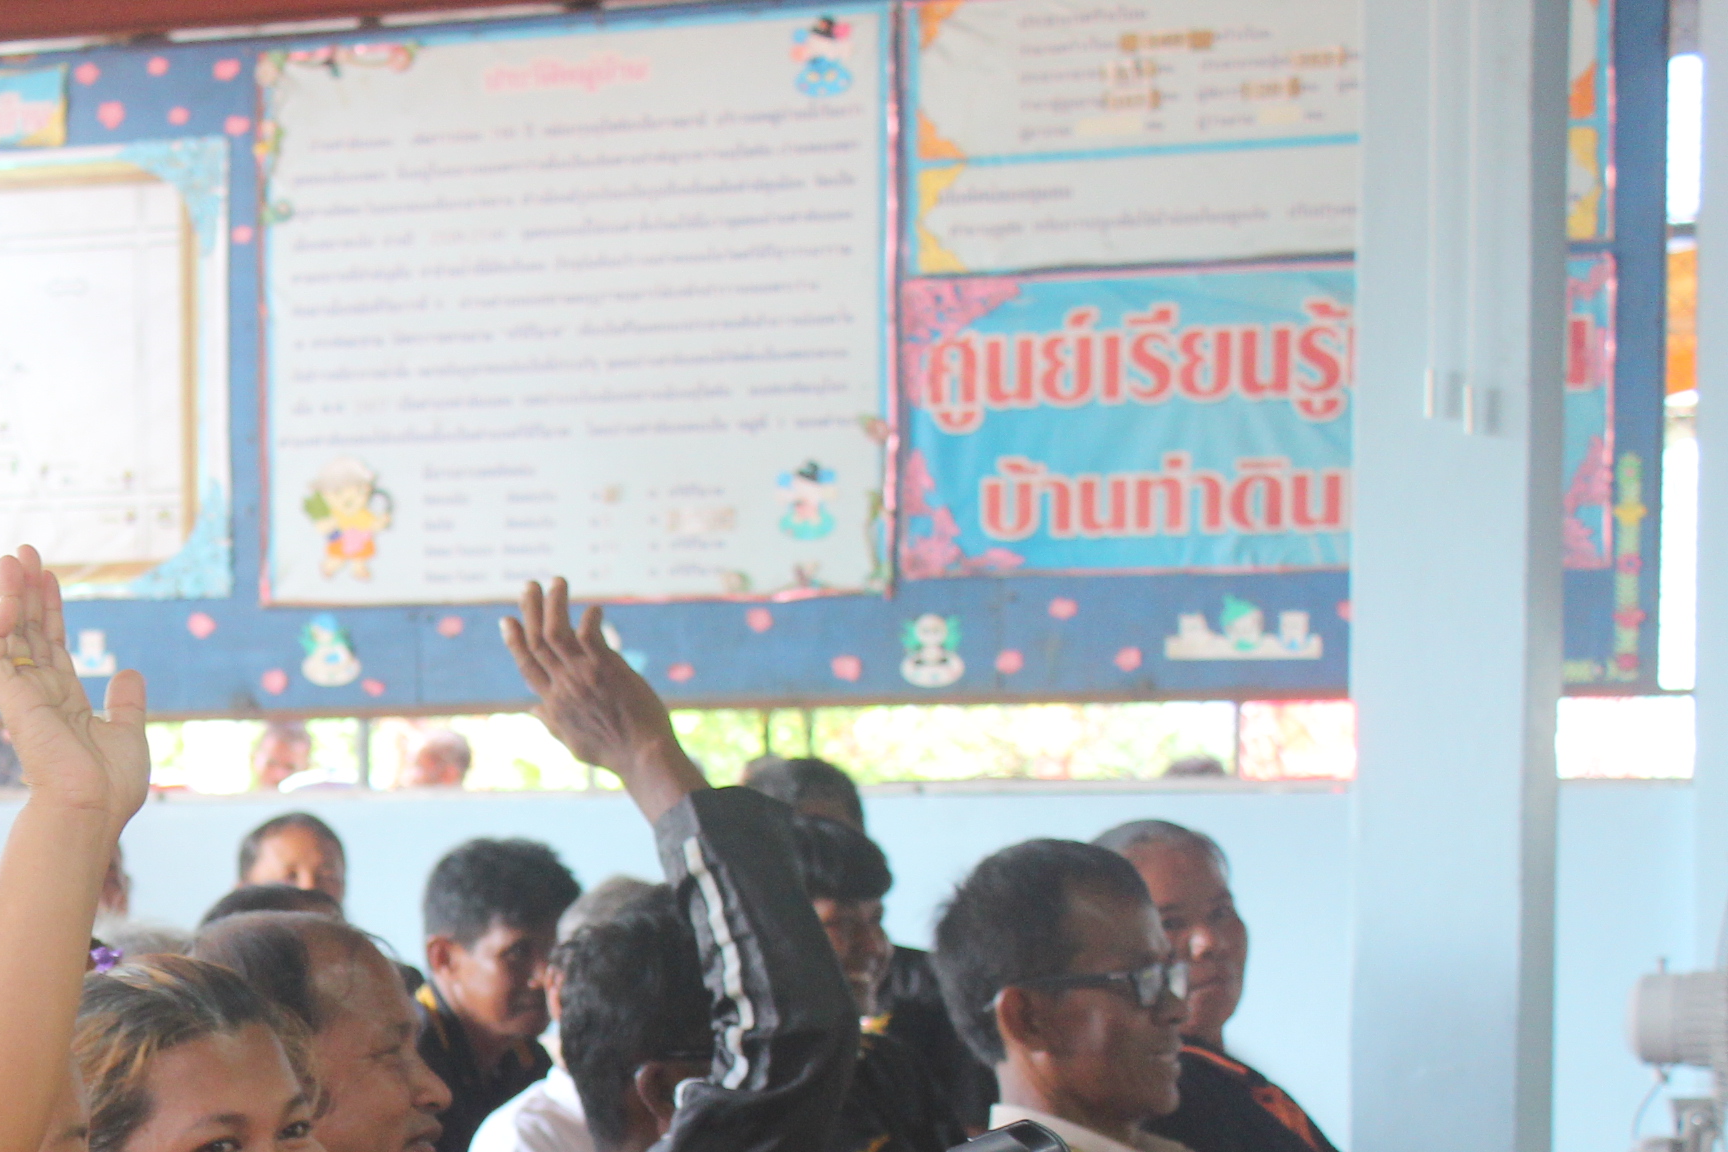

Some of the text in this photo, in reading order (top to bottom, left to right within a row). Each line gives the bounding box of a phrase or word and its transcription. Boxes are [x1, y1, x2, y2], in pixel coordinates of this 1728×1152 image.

[927, 300, 1355, 432] ศูนย์เรียนรู้
[981, 453, 1345, 540] บ้านท่าดิน
